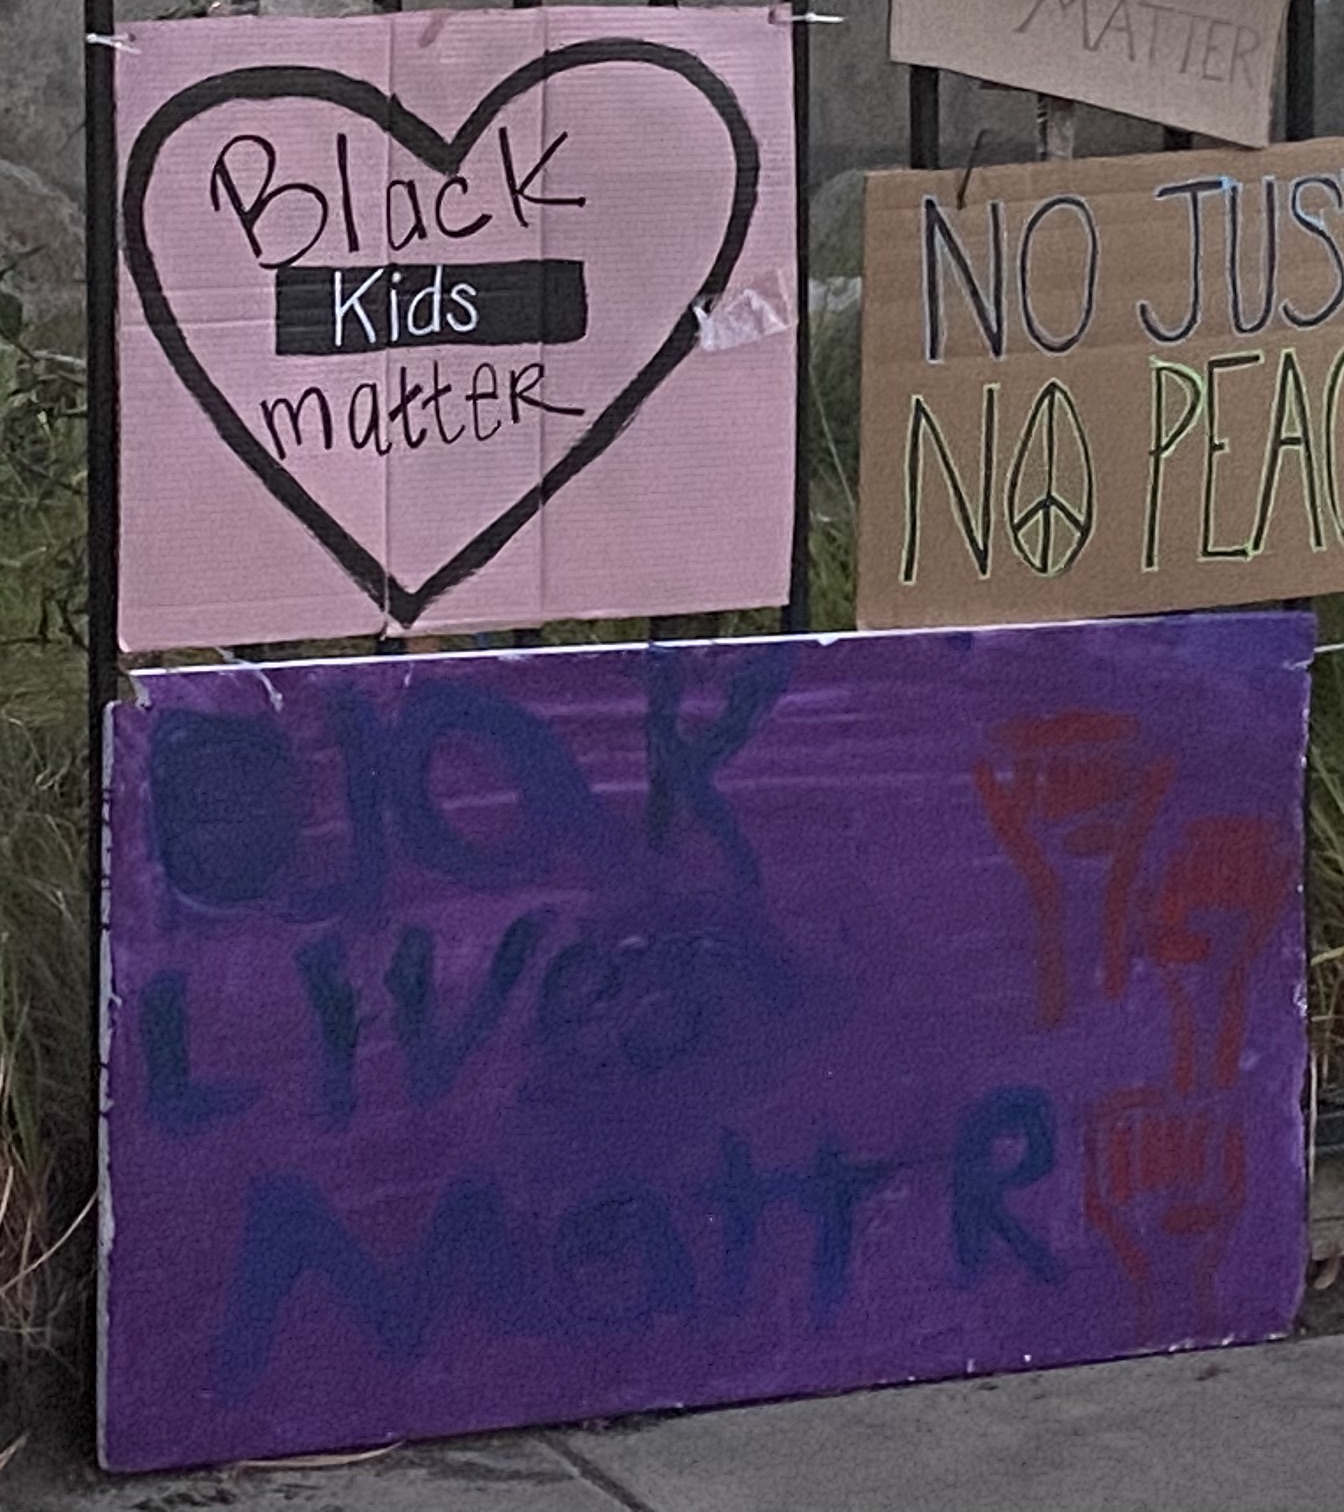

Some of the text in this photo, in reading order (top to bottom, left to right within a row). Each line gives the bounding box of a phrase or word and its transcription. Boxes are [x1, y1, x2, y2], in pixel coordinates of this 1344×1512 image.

[332, 264, 480, 347] Kids
[921, 194, 1100, 364] NO
[899, 377, 1095, 586] NO
